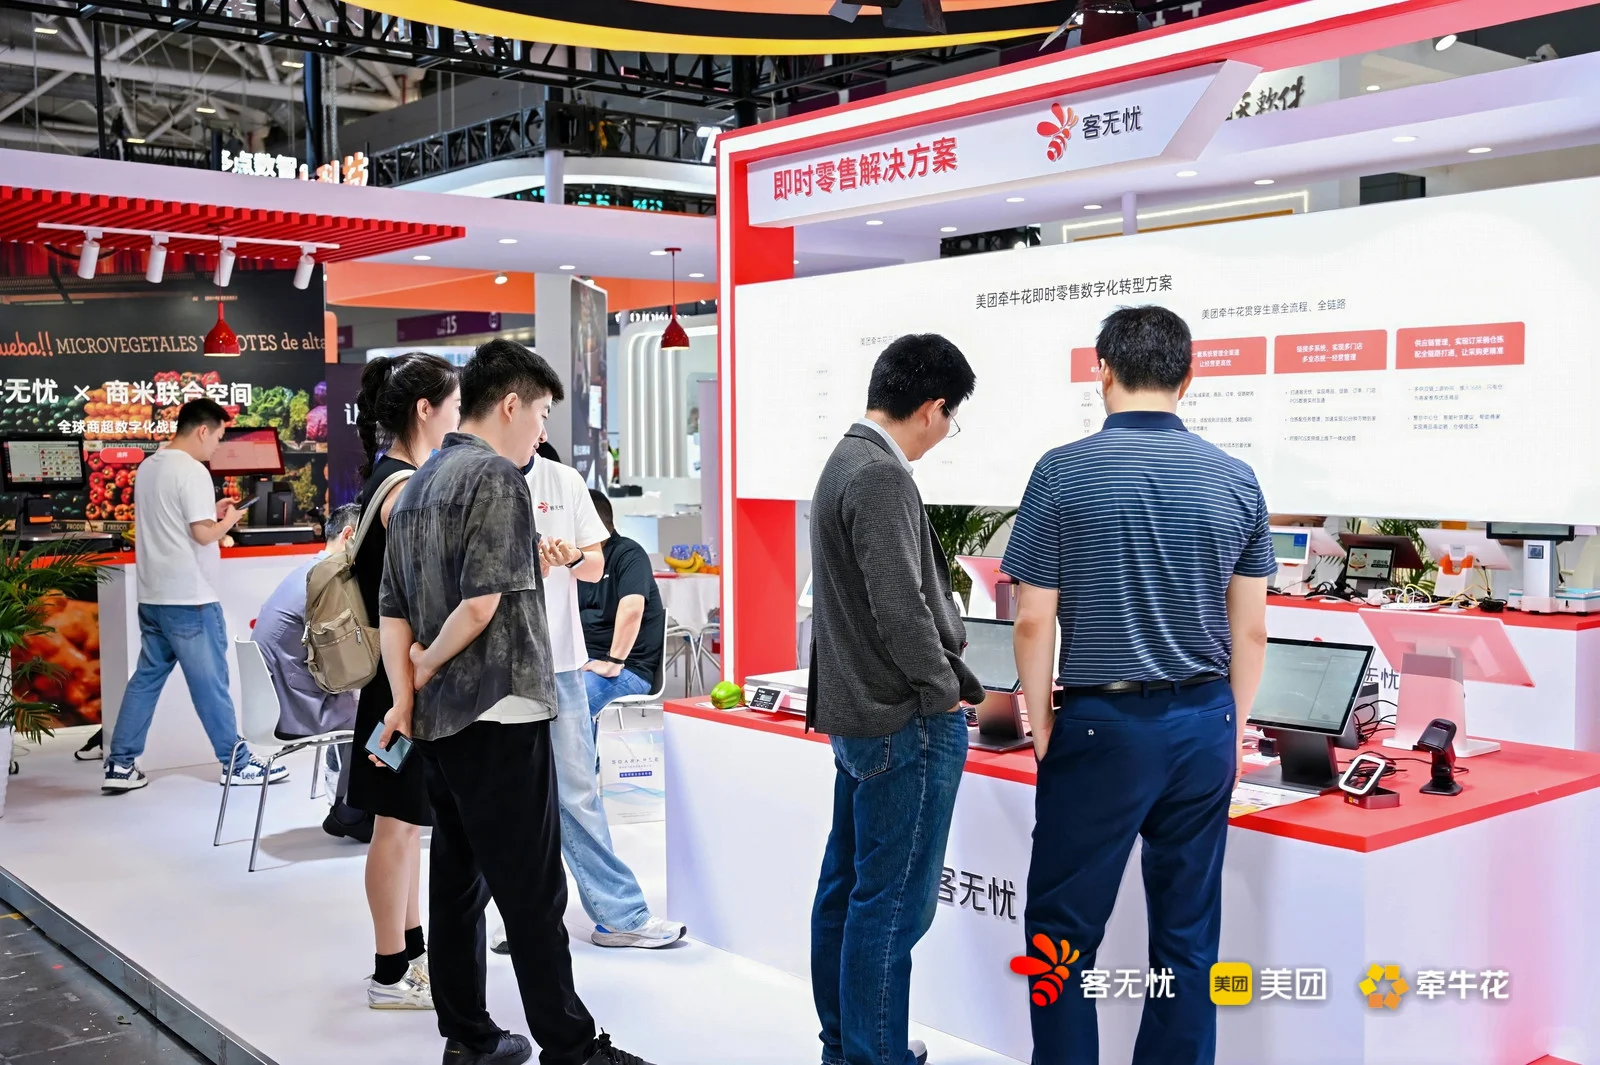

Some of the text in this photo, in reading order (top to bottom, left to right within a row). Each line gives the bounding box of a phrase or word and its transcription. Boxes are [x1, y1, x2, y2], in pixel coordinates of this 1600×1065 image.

[1082, 105, 1141, 139] 客无忧
[773, 136, 958, 201] 即时零售解决方案
[975, 274, 1173, 309] 美团牵牛花即时零售数字化转型方案
[1201, 298, 1347, 320] 美团牵牛花贯穿生意全流程、全链路
[56, 336, 198, 355] MICROVEGETALES
[236, 333, 278, 352] OTES
[281, 332, 298, 351] de
[302, 332, 326, 351] alta
[0, 378, 59, 404] 无忧
[105, 379, 252, 409] 商米联合空间
[242, 772, 255, 780] Lee
[938, 867, 1016, 920] 客无忧
